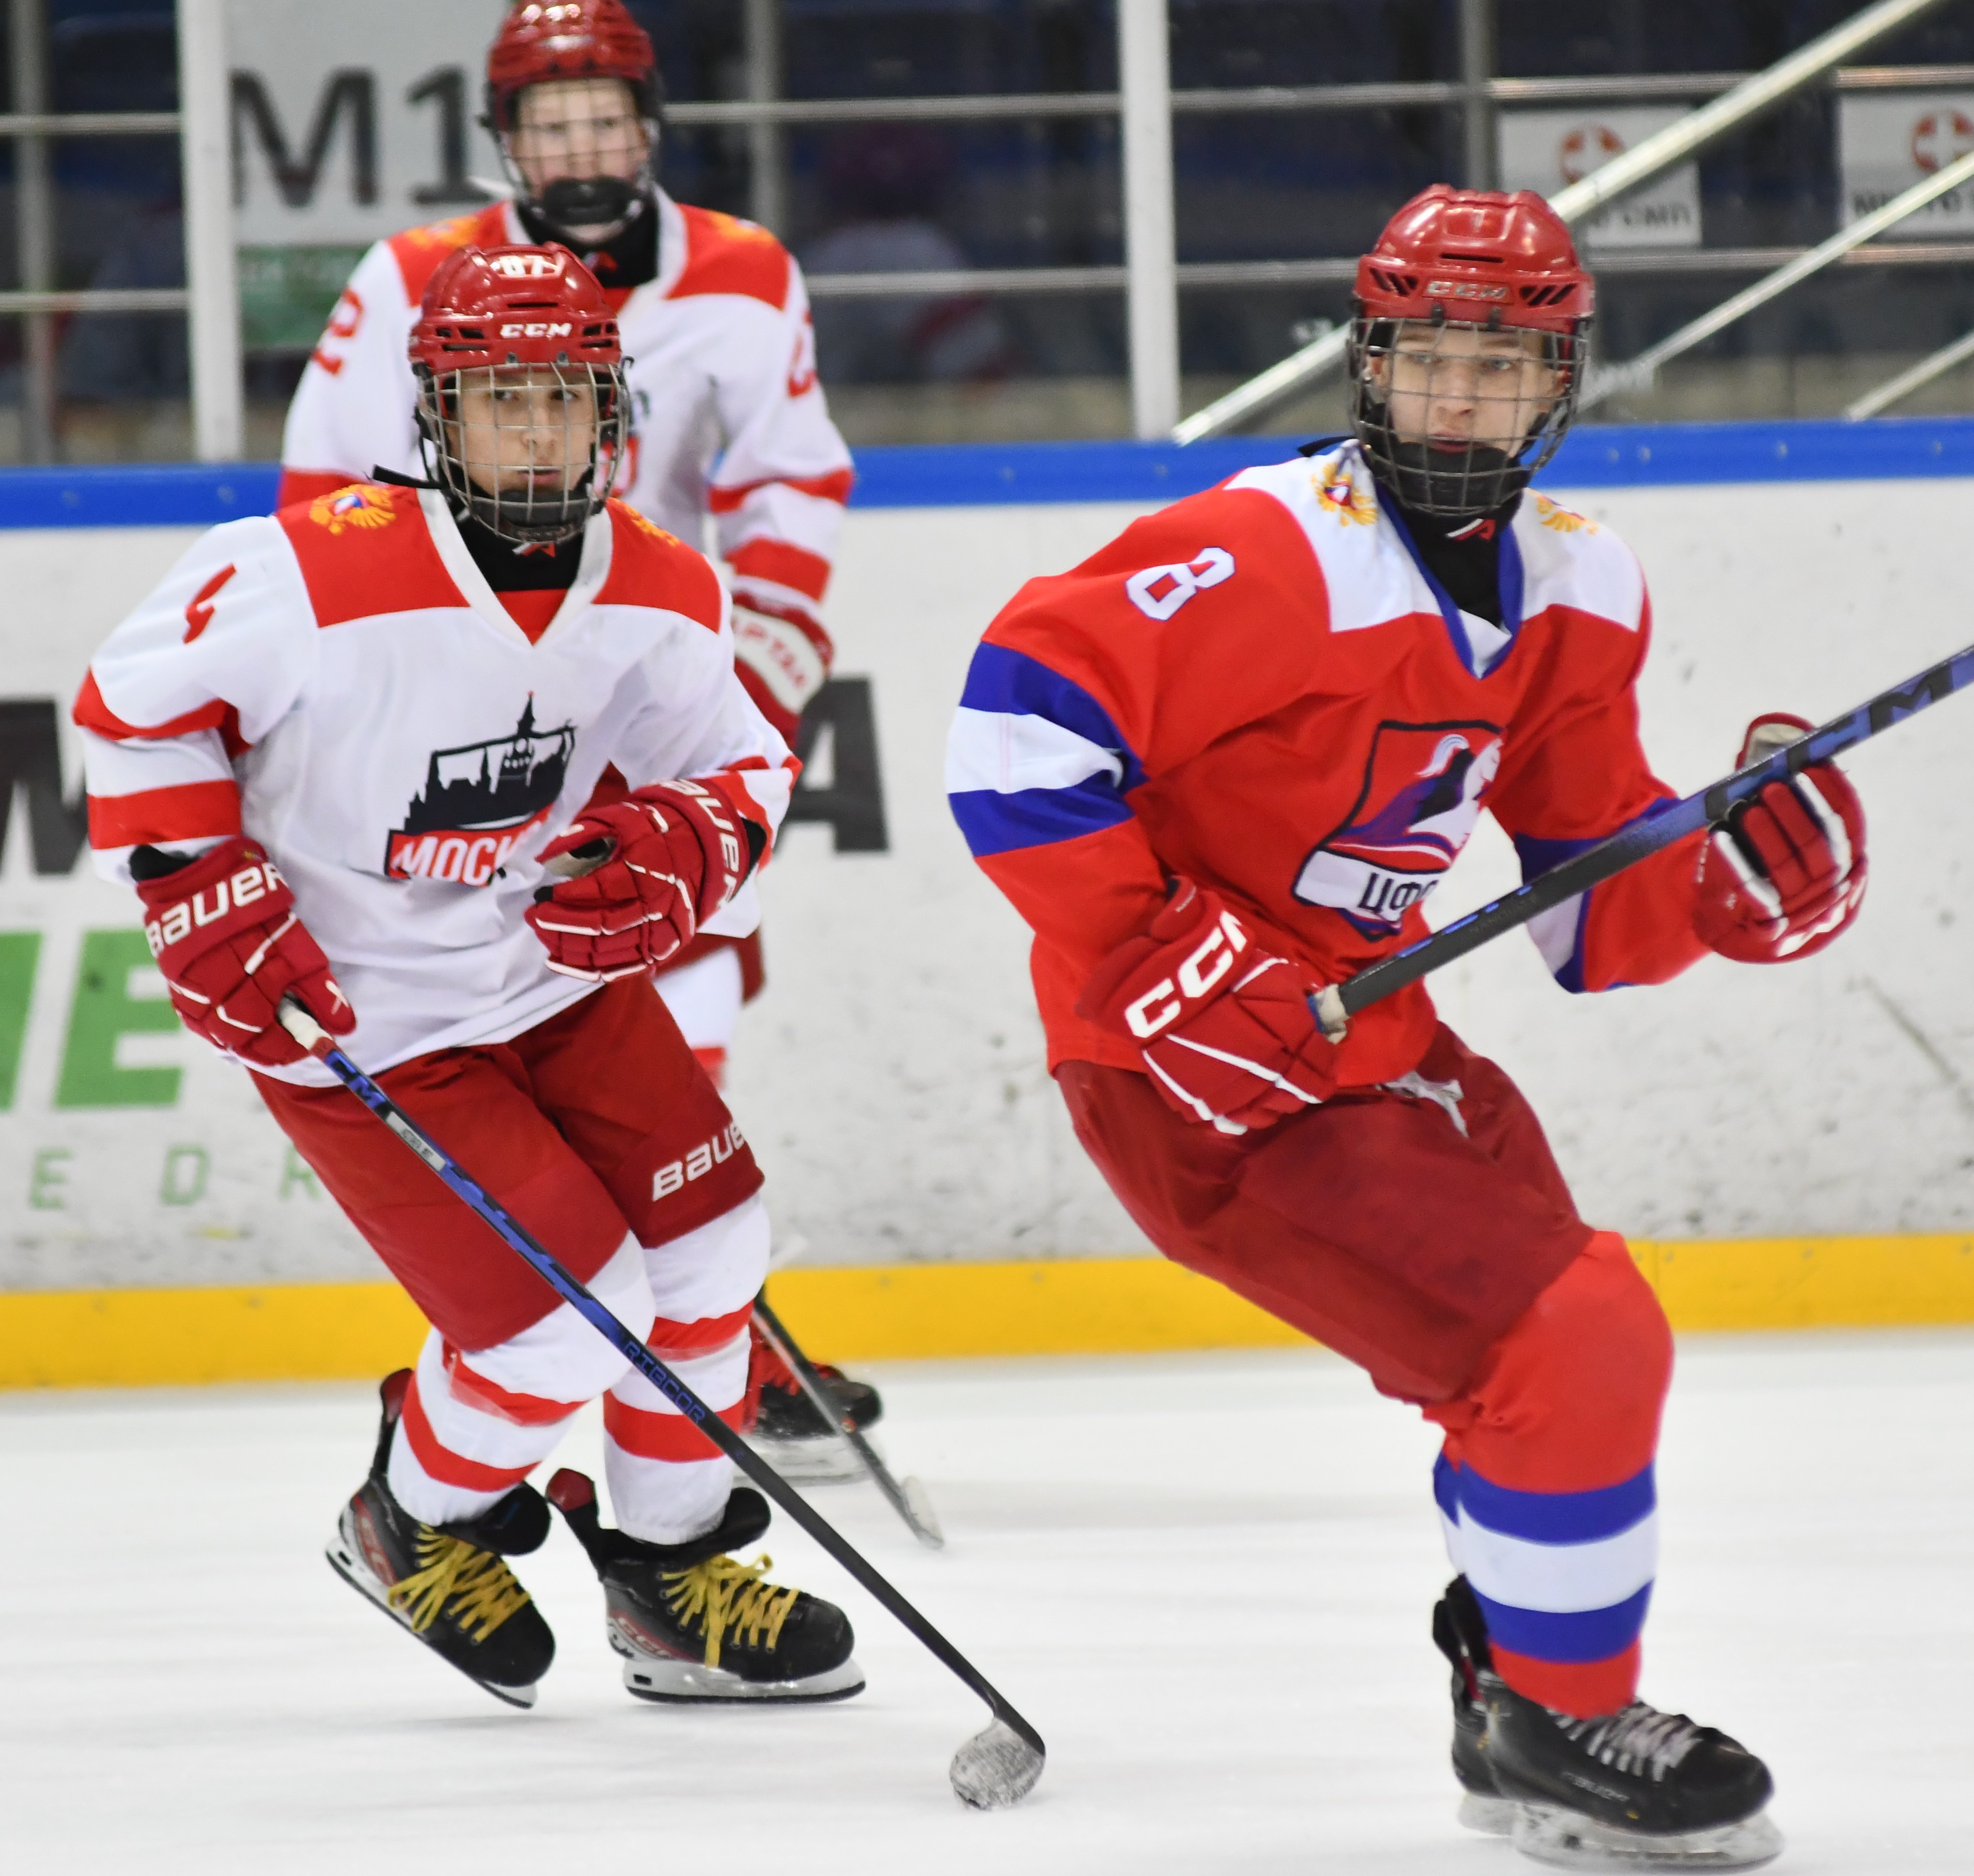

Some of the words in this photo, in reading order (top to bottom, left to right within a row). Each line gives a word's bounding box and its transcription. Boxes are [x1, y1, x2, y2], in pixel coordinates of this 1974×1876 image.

[1427, 280, 1509, 300] CCM
[500, 322, 573, 340] CCM
[1125, 545, 1236, 621] 8
[661, 778, 739, 910] AUER
[652, 1120, 745, 1202] BAUE
[623, 1340, 706, 1424] RIBCOR
